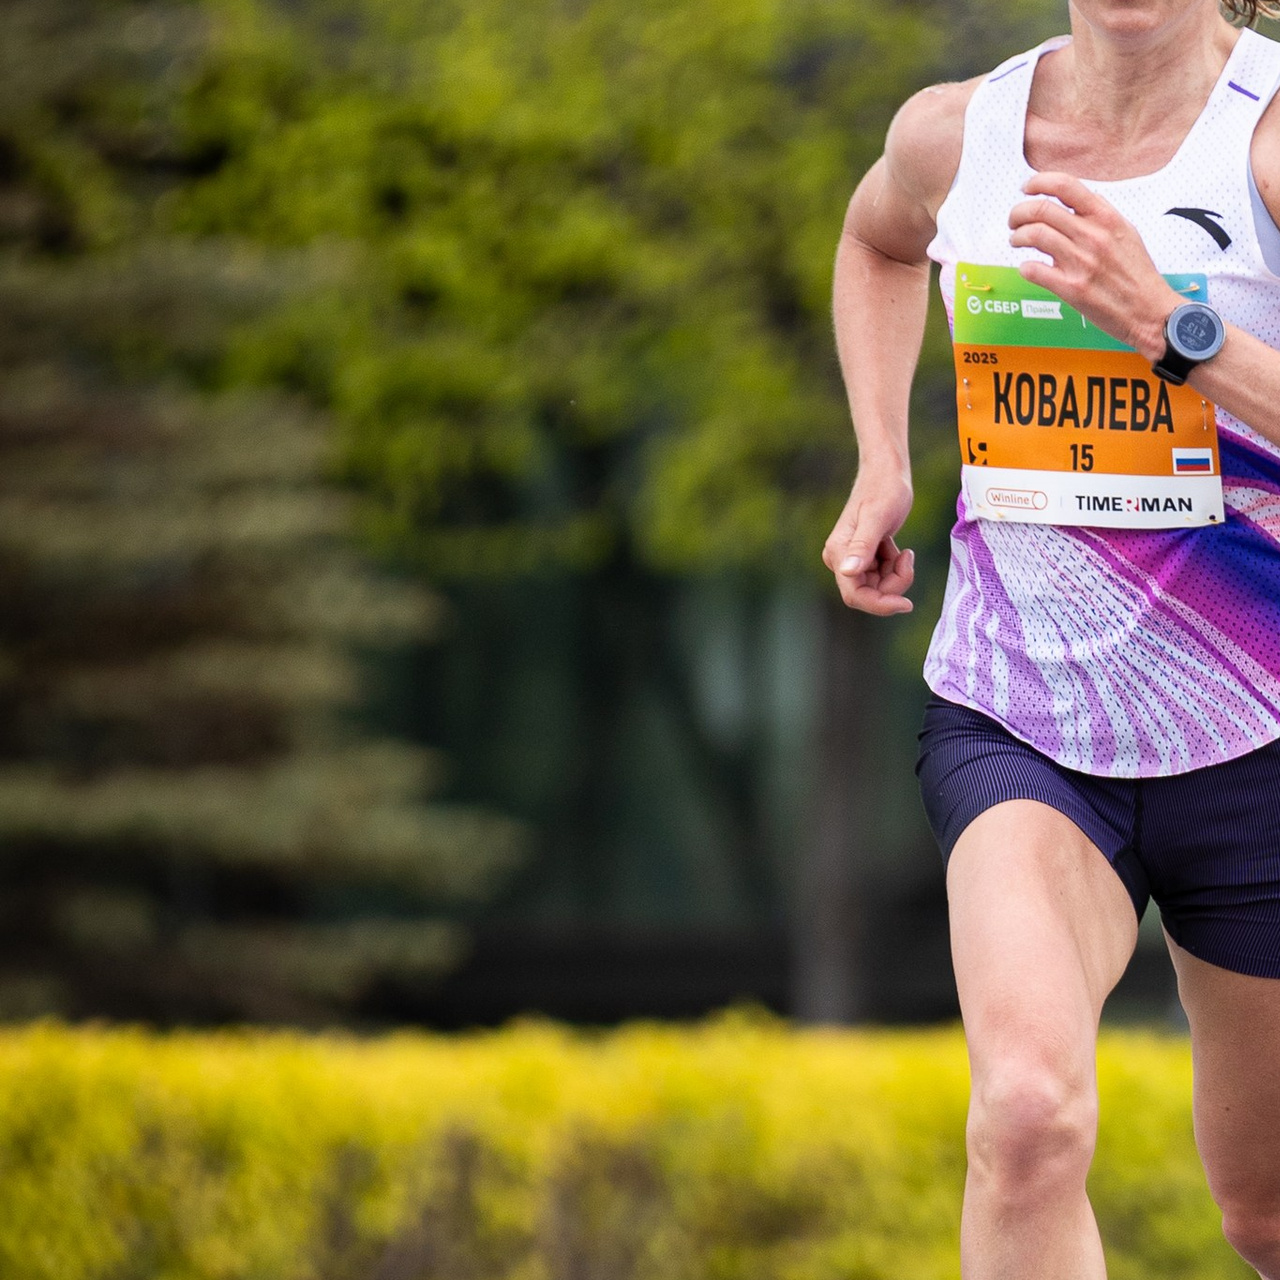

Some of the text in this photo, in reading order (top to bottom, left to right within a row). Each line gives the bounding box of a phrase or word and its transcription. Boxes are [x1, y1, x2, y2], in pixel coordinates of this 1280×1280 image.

[984, 299, 1055, 315] СБЕР Прайм
[963, 351, 998, 365] 2025
[993, 371, 1175, 434] КОВАЛЕВА
[1070, 443, 1094, 472] 15
[990, 492, 1031, 506] Winline
